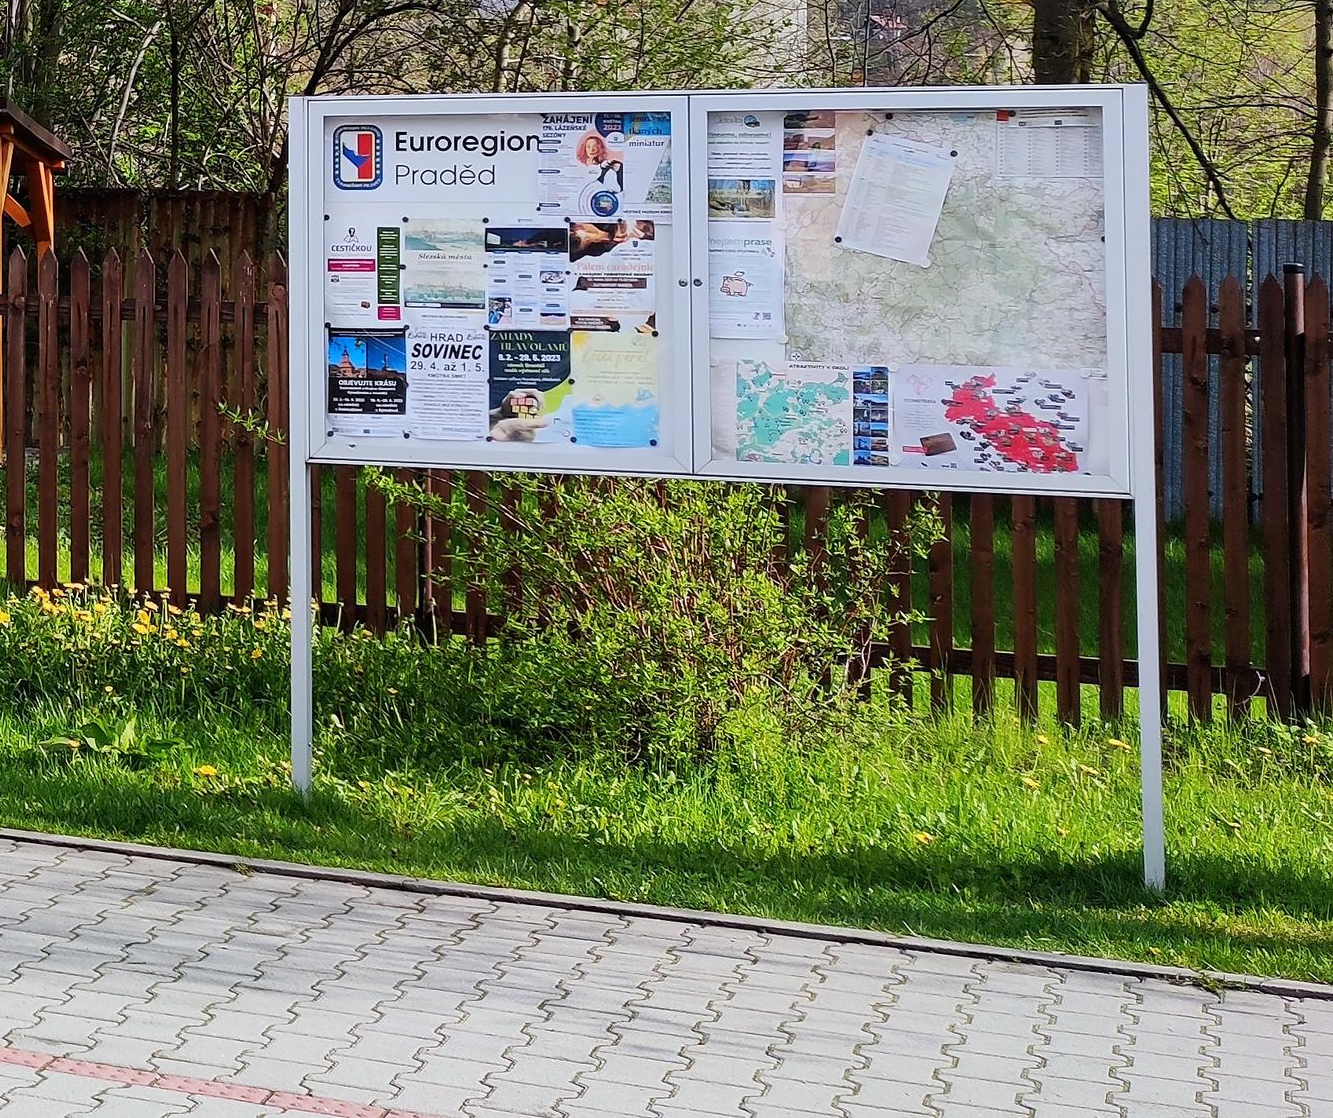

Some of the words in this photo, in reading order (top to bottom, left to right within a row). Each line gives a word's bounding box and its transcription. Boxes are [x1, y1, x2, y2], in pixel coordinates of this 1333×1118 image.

[395, 130, 540, 157] Euroregion
[628, 139, 665, 149] miniatur
[395, 164, 496, 186] Praděd
[331, 243, 373, 252] CESTIČKOU
[429, 333, 464, 343] HRAD
[411, 343, 483, 360] SOVINEC
[410, 360, 427, 371] 29.
[429, 361, 440, 371] 4.
[444, 362, 457, 372] až
[461, 362, 471, 372] 1.
[474, 362, 485, 373] 5.
